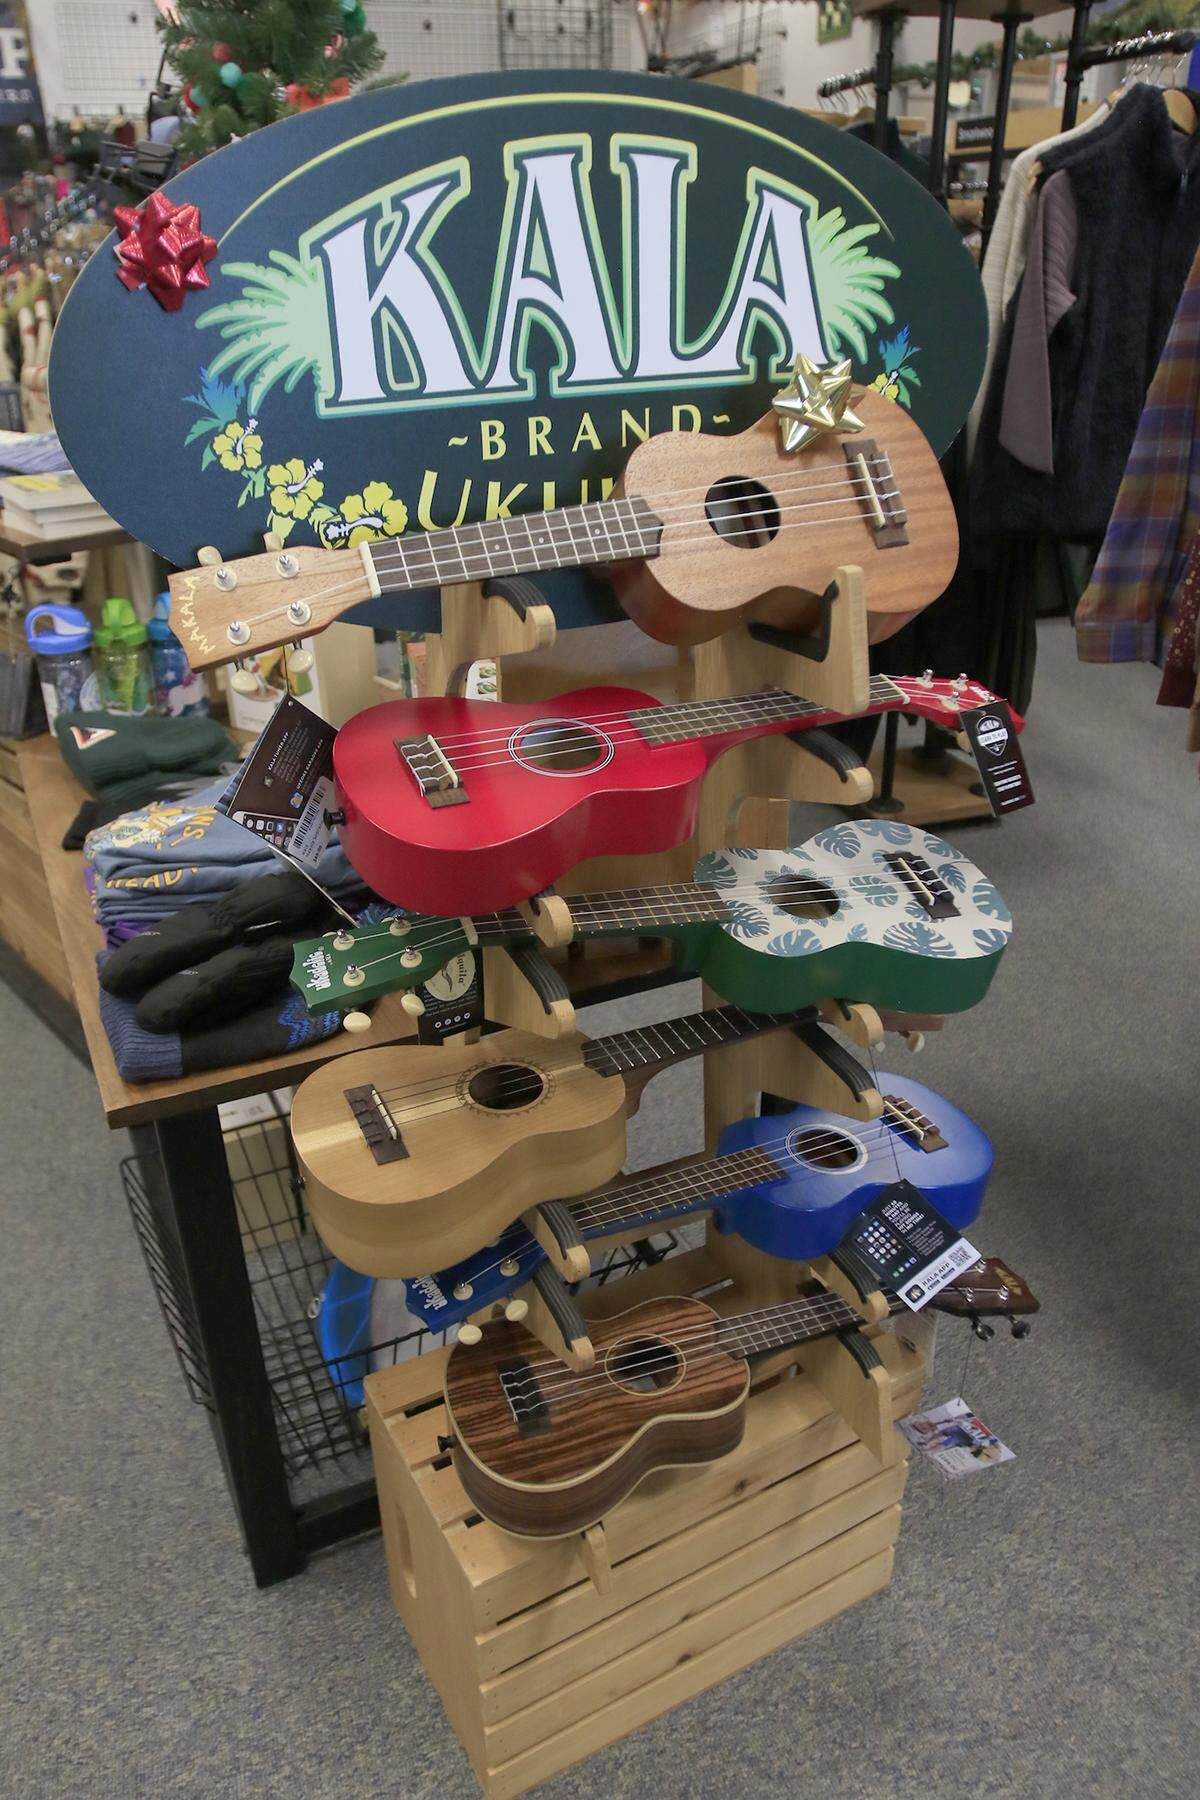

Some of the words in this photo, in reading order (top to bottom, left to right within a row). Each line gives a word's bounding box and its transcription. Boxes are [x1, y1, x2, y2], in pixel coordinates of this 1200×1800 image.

[312, 142, 836, 410] KALA
[178, 575, 217, 656] MAKALA
[268, 758, 276, 771] KALA
[275, 741, 285, 759] TUNER
